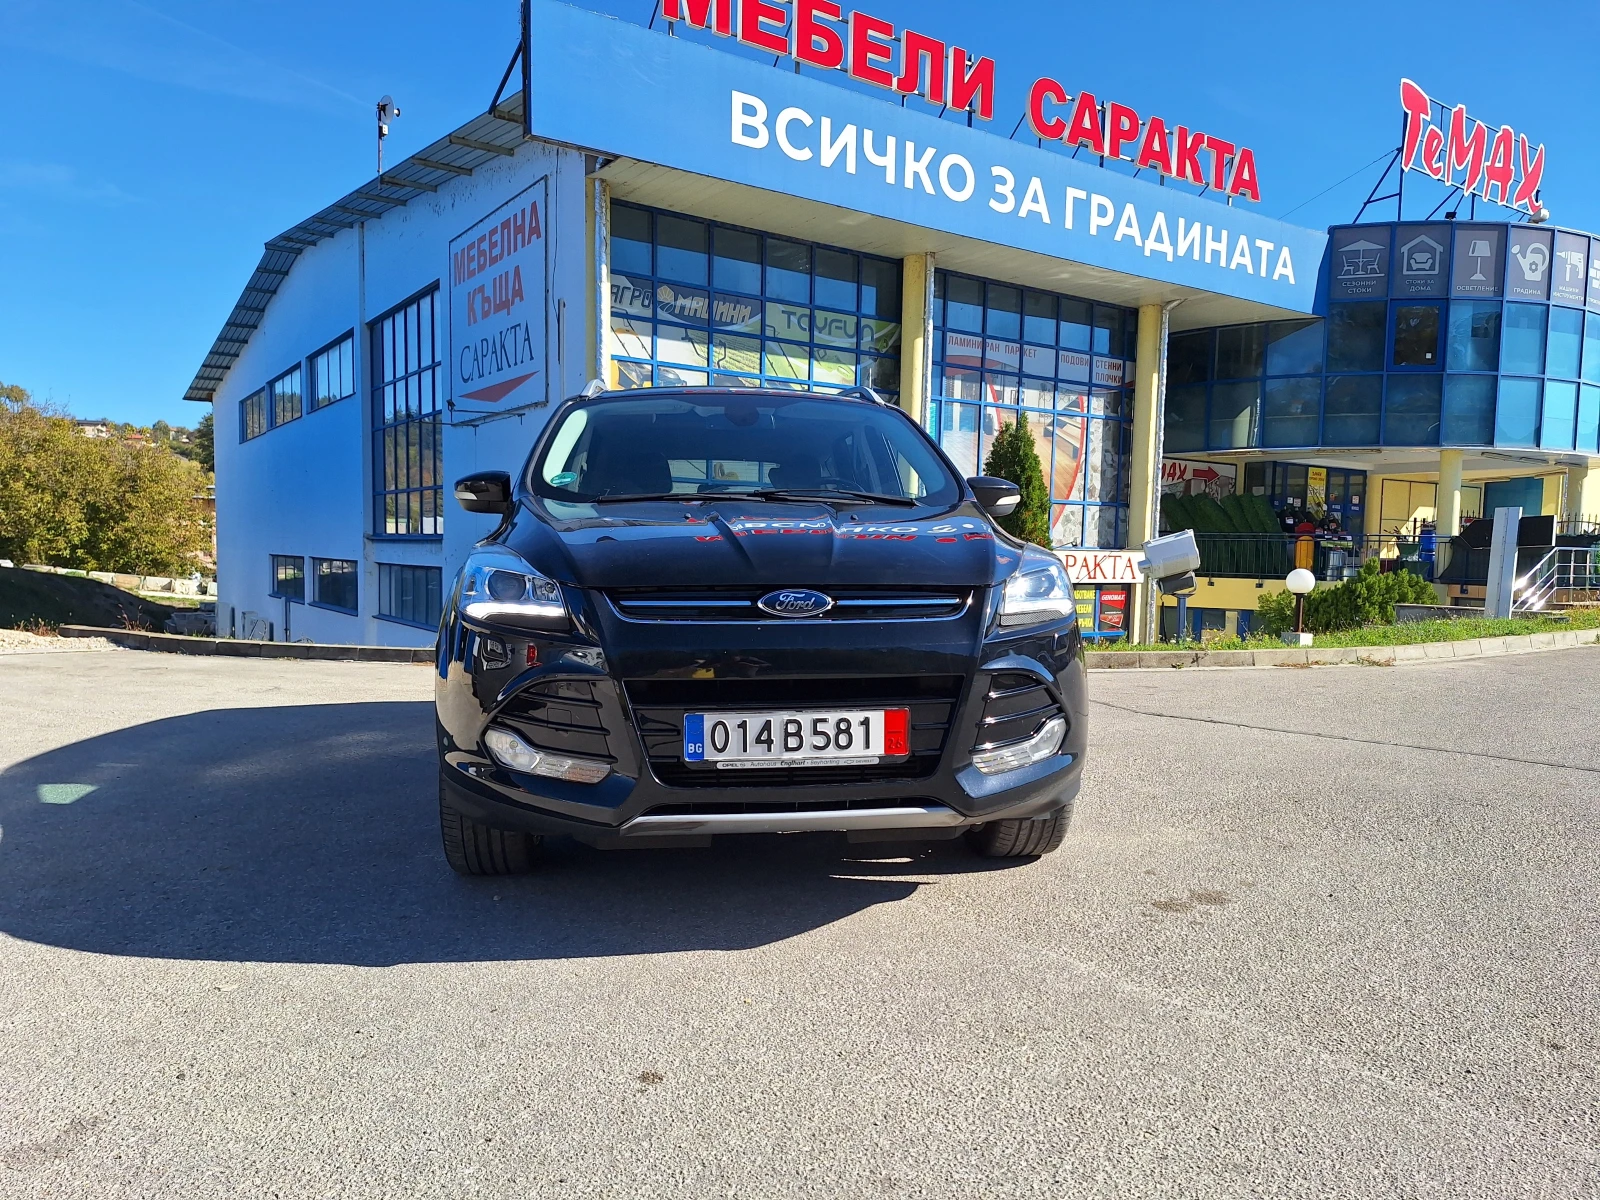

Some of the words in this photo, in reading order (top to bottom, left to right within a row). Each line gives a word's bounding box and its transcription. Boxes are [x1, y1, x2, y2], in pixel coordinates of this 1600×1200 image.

[1026, 77, 1261, 202] САРАКТА
[731, 90, 976, 202] ВСИЧКО
[988, 165, 1051, 225] ЗА
[1064, 186, 1296, 285] ГРАДИНАТА
[453, 200, 542, 288] МЕБЕЛНА
[467, 264, 524, 327] КЪЩА
[1513, 287, 1541, 295] ГРАДИНА
[459, 319, 534, 384] САРАКТА
[947, 335, 1000, 353] ЛАМИНИРАН
[1004, 344, 1038, 358] ПАРКЕТ
[1060, 354, 1090, 367] ПОДОВИ
[1095, 360, 1122, 371] СТЕННИ
[1095, 373, 1122, 384] ПЛОЧКИ
[1161, 462, 1188, 482] AX
[1065, 554, 1137, 580] РАКТА
[775, 592, 815, 611] Ford
[688, 743, 703, 753] BG
[710, 716, 872, 753] 014B581
[780, 759, 806, 767] Englhart
